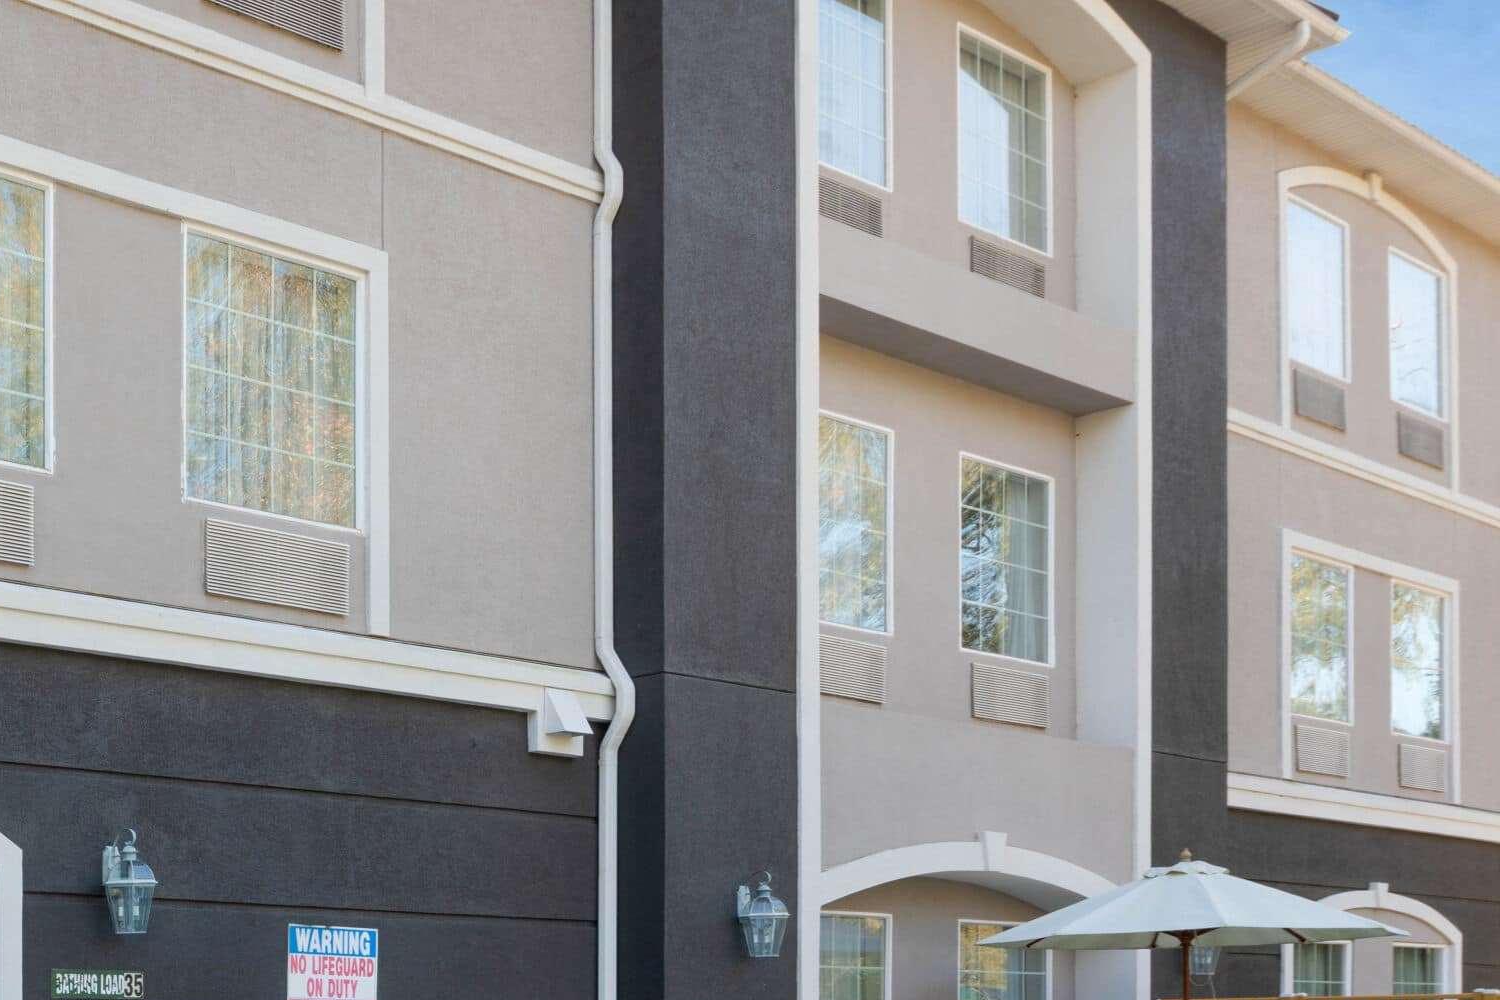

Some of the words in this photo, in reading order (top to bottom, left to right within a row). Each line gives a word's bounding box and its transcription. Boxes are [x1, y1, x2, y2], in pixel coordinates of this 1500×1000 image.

[295, 927, 371, 956] WARNING
[290, 954, 307, 974] NO
[312, 955, 375, 978] LIFEGUARD
[100, 973, 124, 995] LOAD
[124, 973, 143, 997] 35
[306, 977, 323, 997] ON
[328, 978, 358, 998] DUTY
